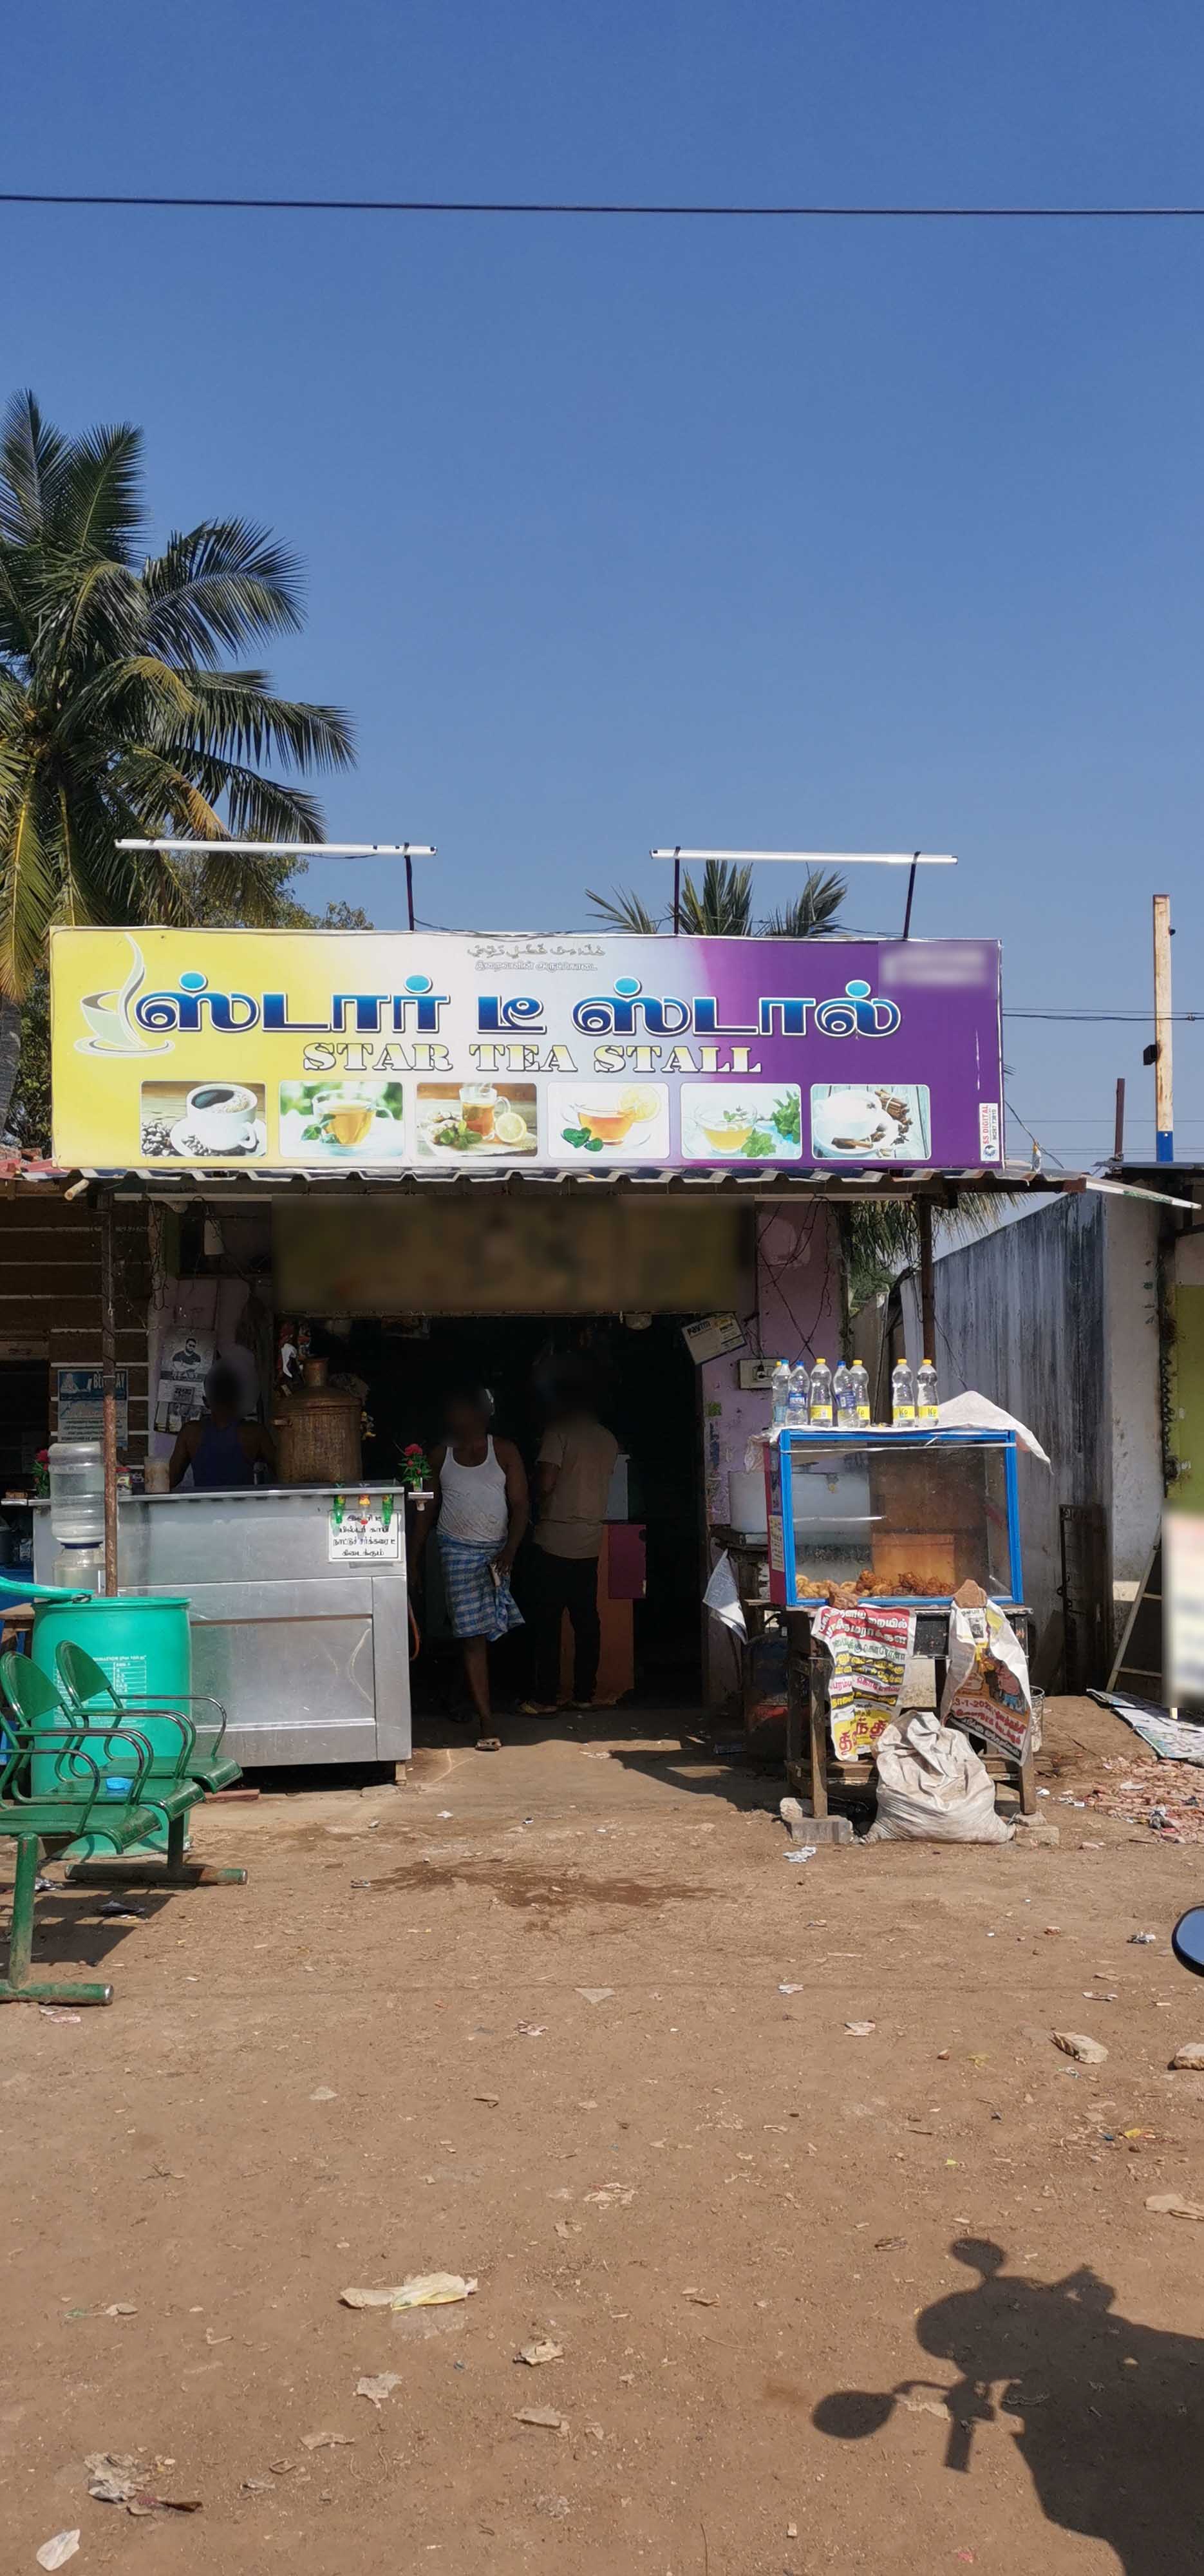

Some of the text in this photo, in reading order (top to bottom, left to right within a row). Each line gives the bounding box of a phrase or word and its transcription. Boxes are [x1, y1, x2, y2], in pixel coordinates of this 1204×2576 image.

[133, 971, 901, 1037] ஸ்டார் டீ ஸ்டால்
[303, 1043, 762, 1074] STAR TEA STALL
